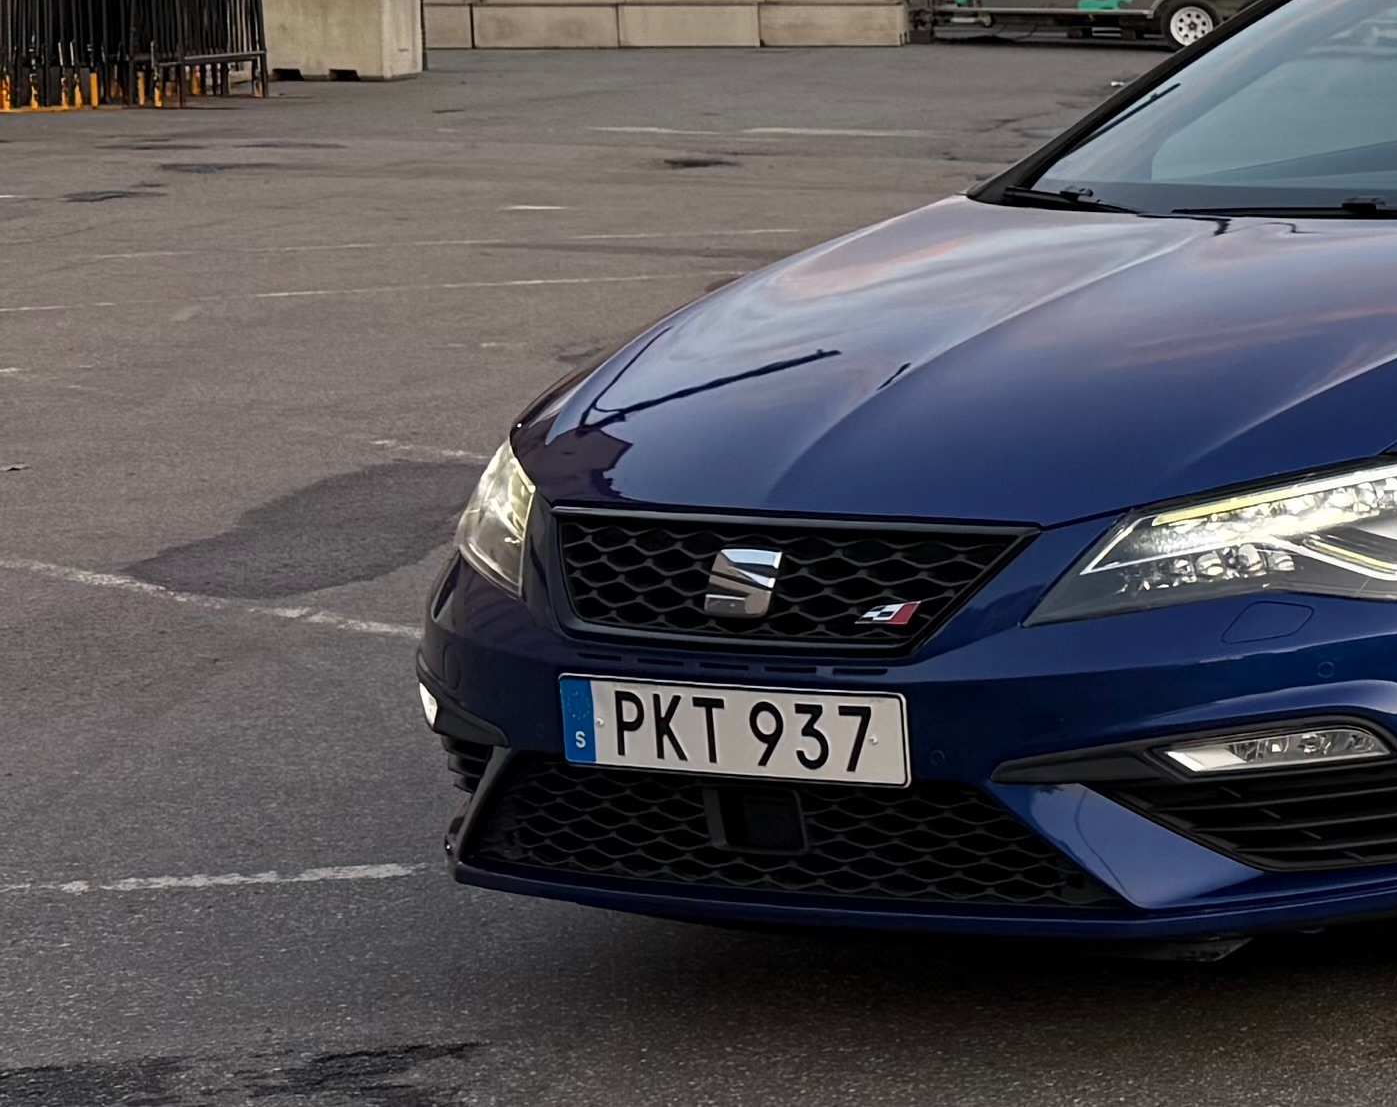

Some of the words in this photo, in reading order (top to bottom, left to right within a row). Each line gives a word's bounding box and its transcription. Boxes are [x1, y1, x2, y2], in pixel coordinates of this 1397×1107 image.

[575, 731, 586, 748] S
[614, 690, 725, 763] PKT
[749, 701, 871, 772] 937
